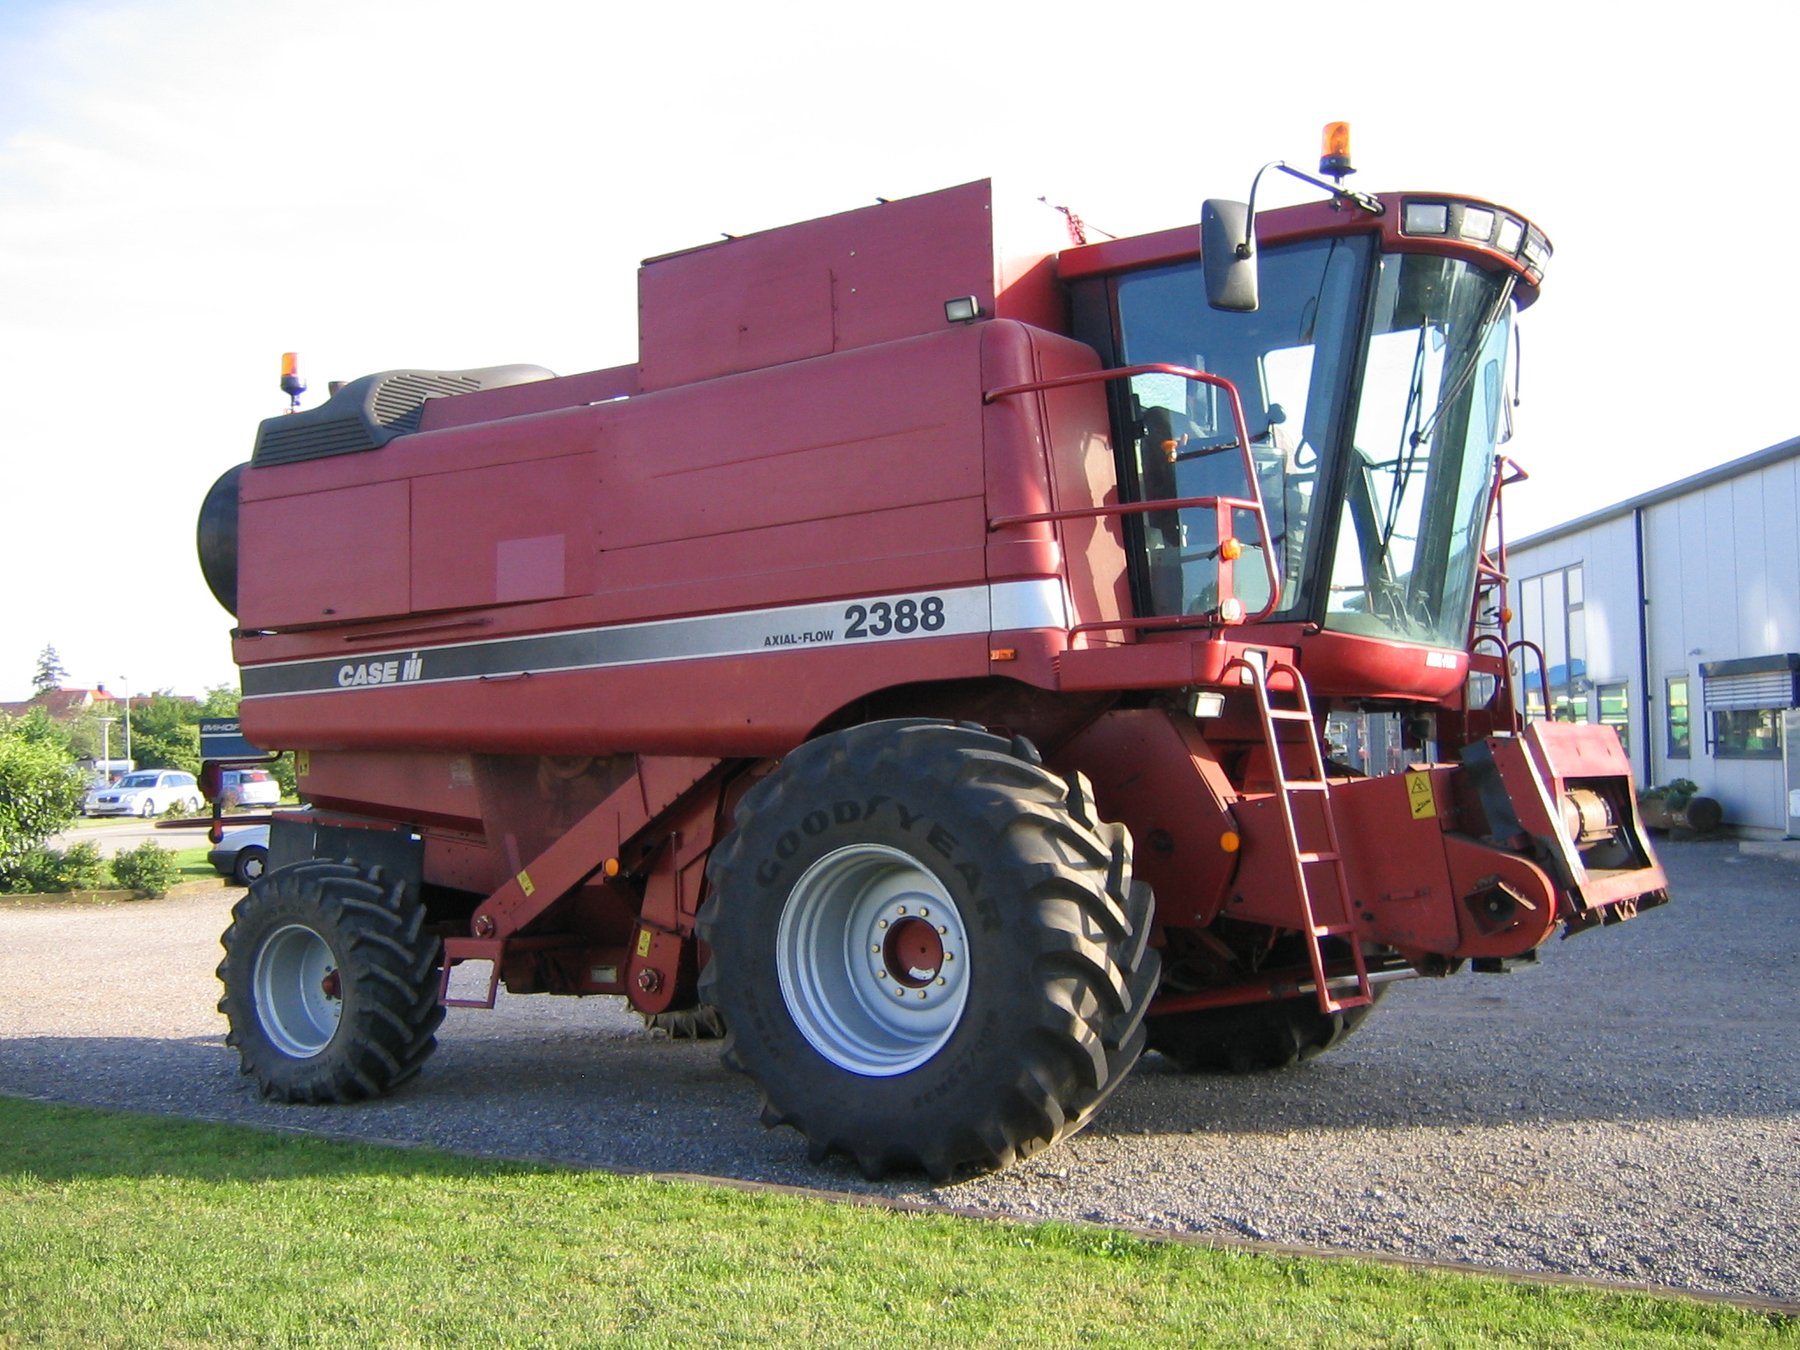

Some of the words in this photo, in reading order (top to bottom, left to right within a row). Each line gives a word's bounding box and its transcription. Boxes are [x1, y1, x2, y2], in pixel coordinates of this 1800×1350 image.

[764, 630, 834, 647] AXIAL-FLOW
[843, 596, 946, 639] 2388
[338, 660, 399, 687] CASE
[756, 795, 1003, 933] GOODYEAR
